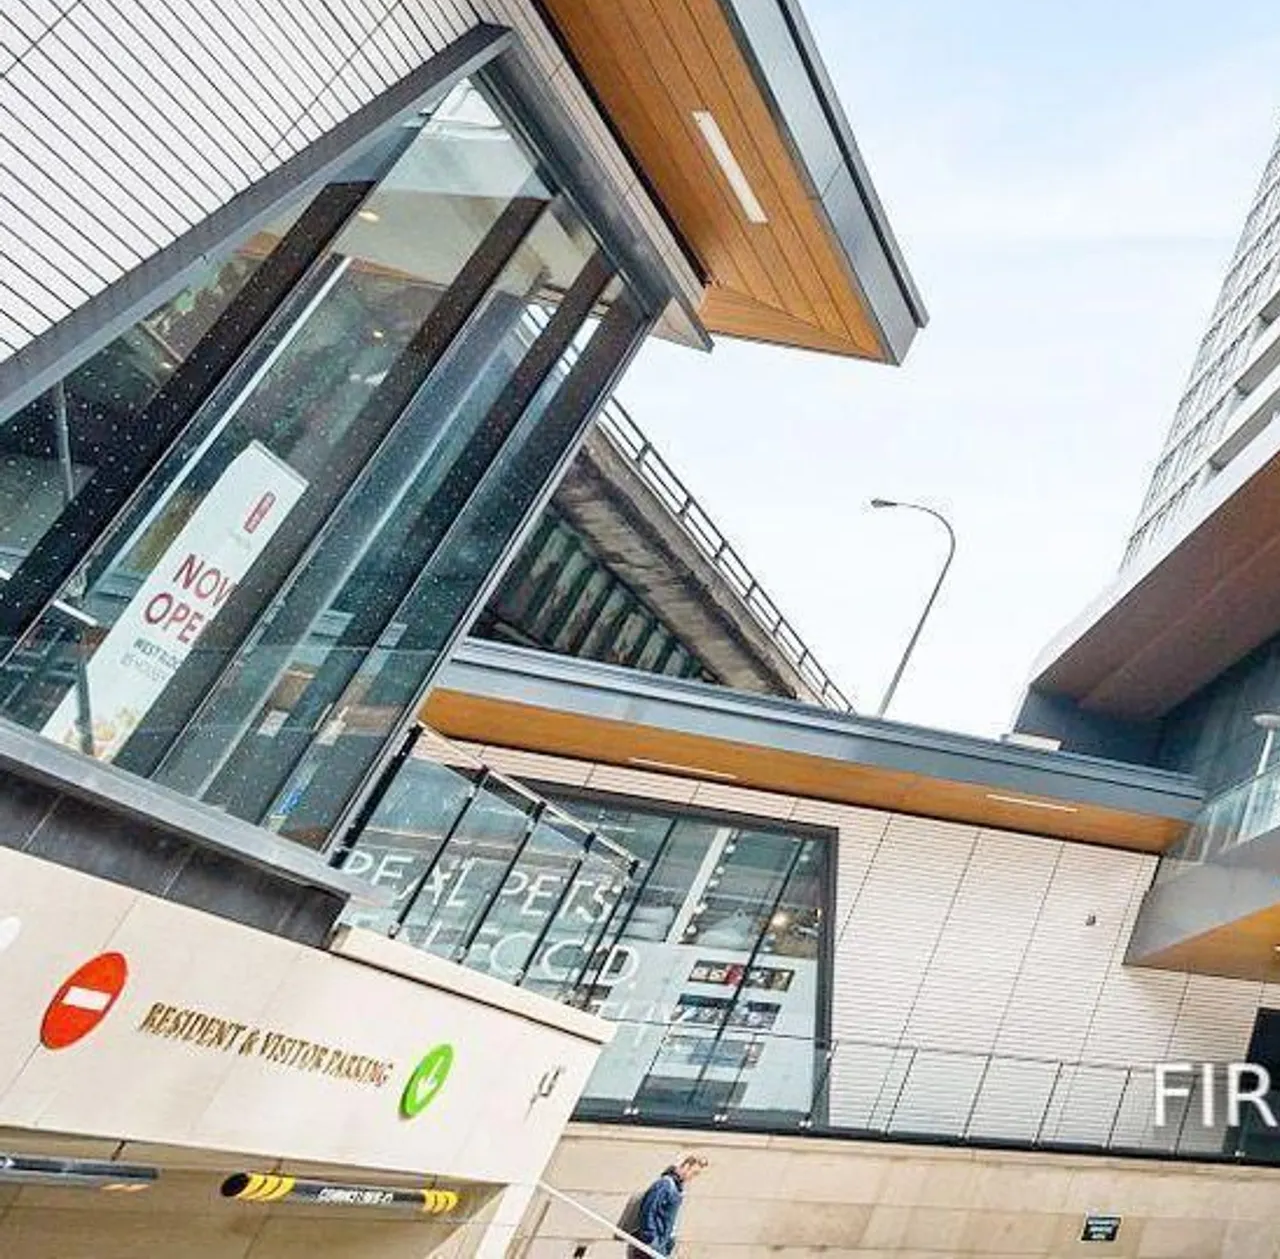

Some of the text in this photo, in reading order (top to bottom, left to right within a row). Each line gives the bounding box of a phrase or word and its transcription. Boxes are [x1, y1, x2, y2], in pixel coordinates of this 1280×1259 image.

[144, 592, 204, 644] OPE
[501, 871, 622, 923] PETS
[139, 1001, 395, 1087] RESIDENT & VISITOR PARKING
